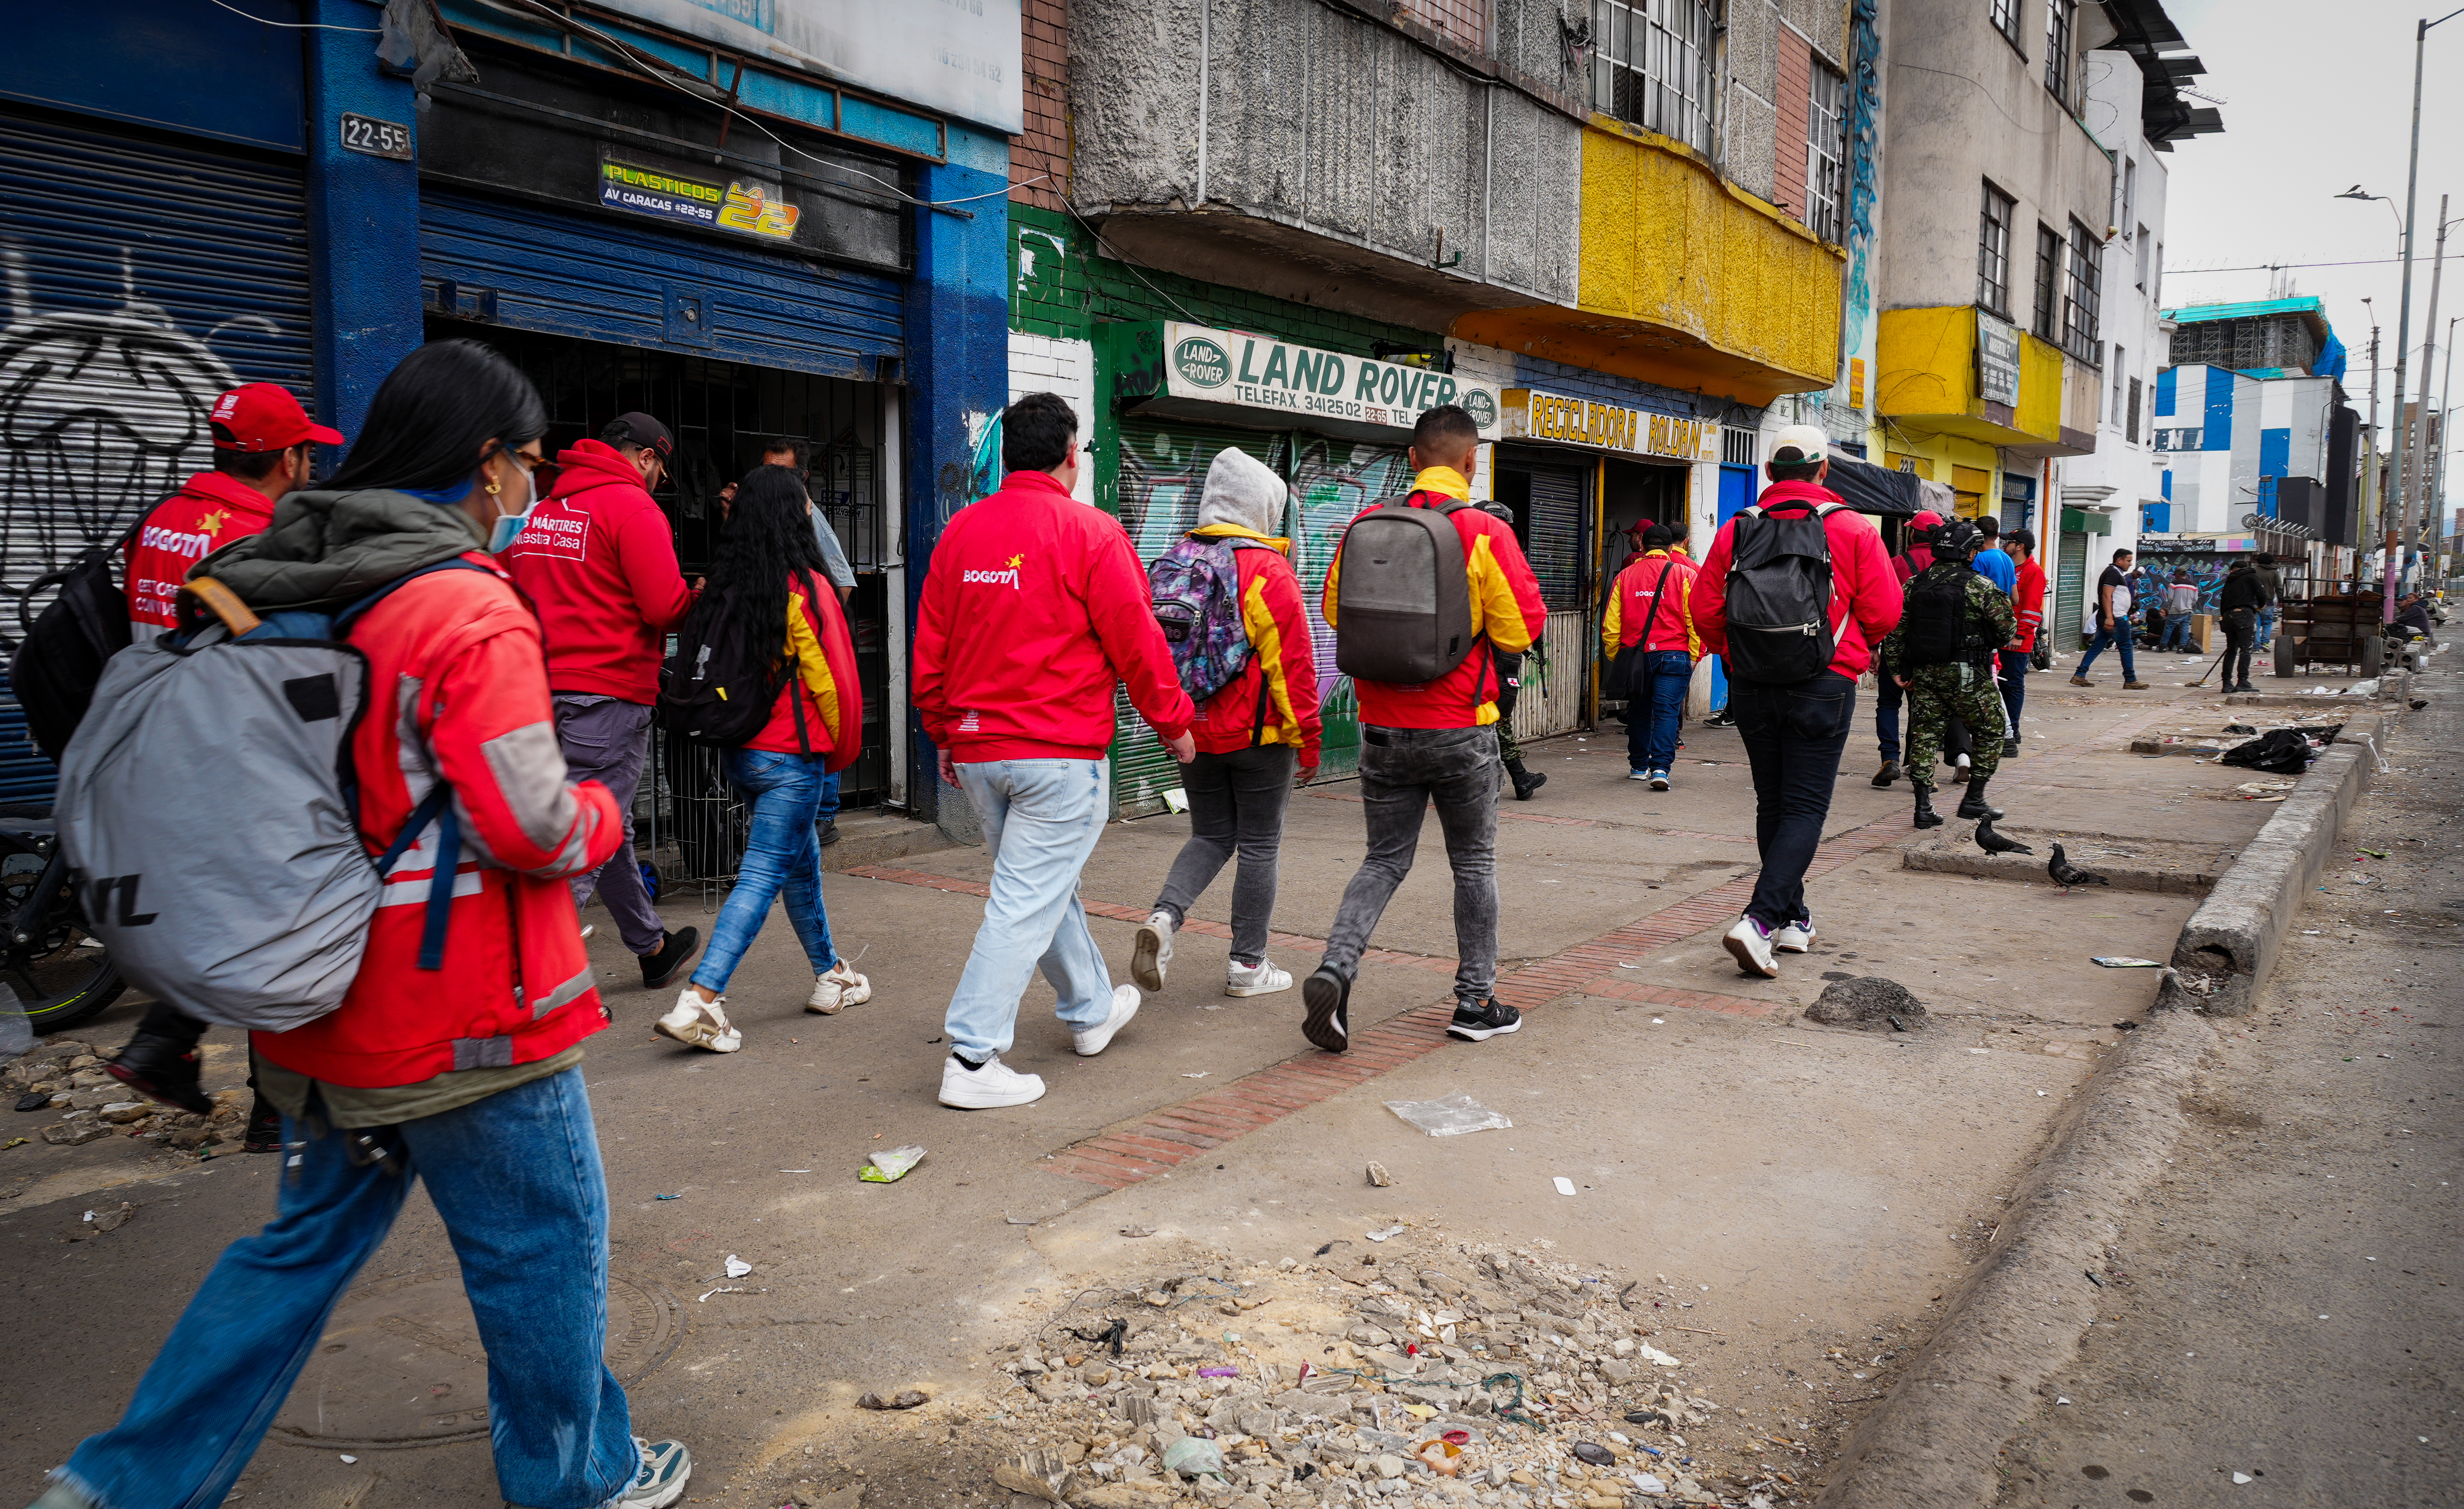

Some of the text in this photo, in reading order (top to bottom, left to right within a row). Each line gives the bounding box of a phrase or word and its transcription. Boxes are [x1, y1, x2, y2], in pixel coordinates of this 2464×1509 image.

[988, 64, 1001, 83] 52
[347, 120, 406, 152] 22-55
[608, 165, 718, 202] PLASTICOS
[729, 182, 765, 200] LA
[605, 188, 713, 220] AV CARACAS #22-55
[716, 193, 799, 238] 22
[1183, 343, 1213, 363] LAND
[1189, 363, 1223, 382] ROVER
[1238, 339, 1457, 411] LAND ROVER
[1234, 385, 1300, 409] TELEFAX.
[1366, 408, 1387, 423] 22-65
[1392, 409, 1414, 425] TEL.
[1469, 393, 1487, 409] LAND
[1647, 414, 1702, 459] ROLDAN
[1704, 424, 1717, 435] COMPRA
[1701, 450, 1714, 461] VENTA
[532, 514, 584, 534] MÁRTIRES
[553, 532, 580, 550] Casa
